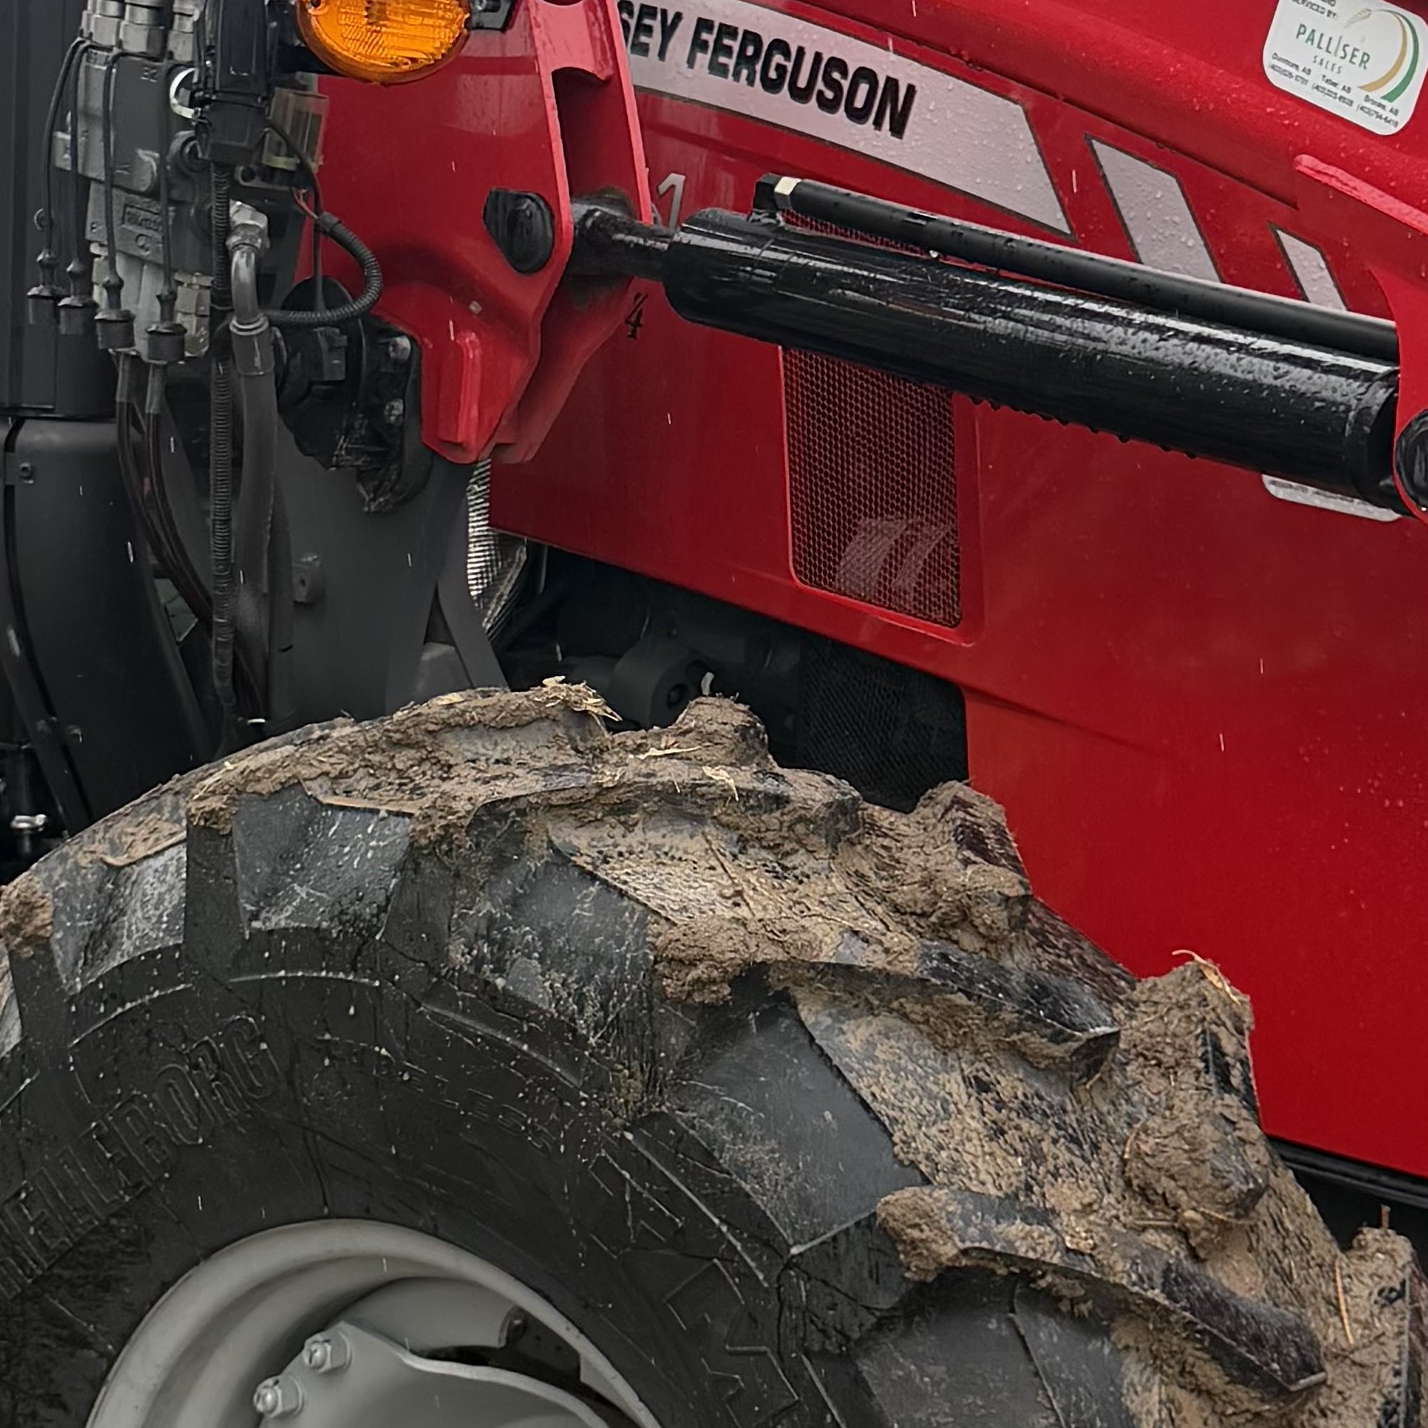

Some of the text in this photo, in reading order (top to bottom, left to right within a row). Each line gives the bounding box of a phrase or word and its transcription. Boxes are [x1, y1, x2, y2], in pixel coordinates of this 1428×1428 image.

[1295, 22, 1372, 71] PALLISER
[1312, 54, 1343, 76] SALES
[685, 16, 918, 140] FERGUSON
